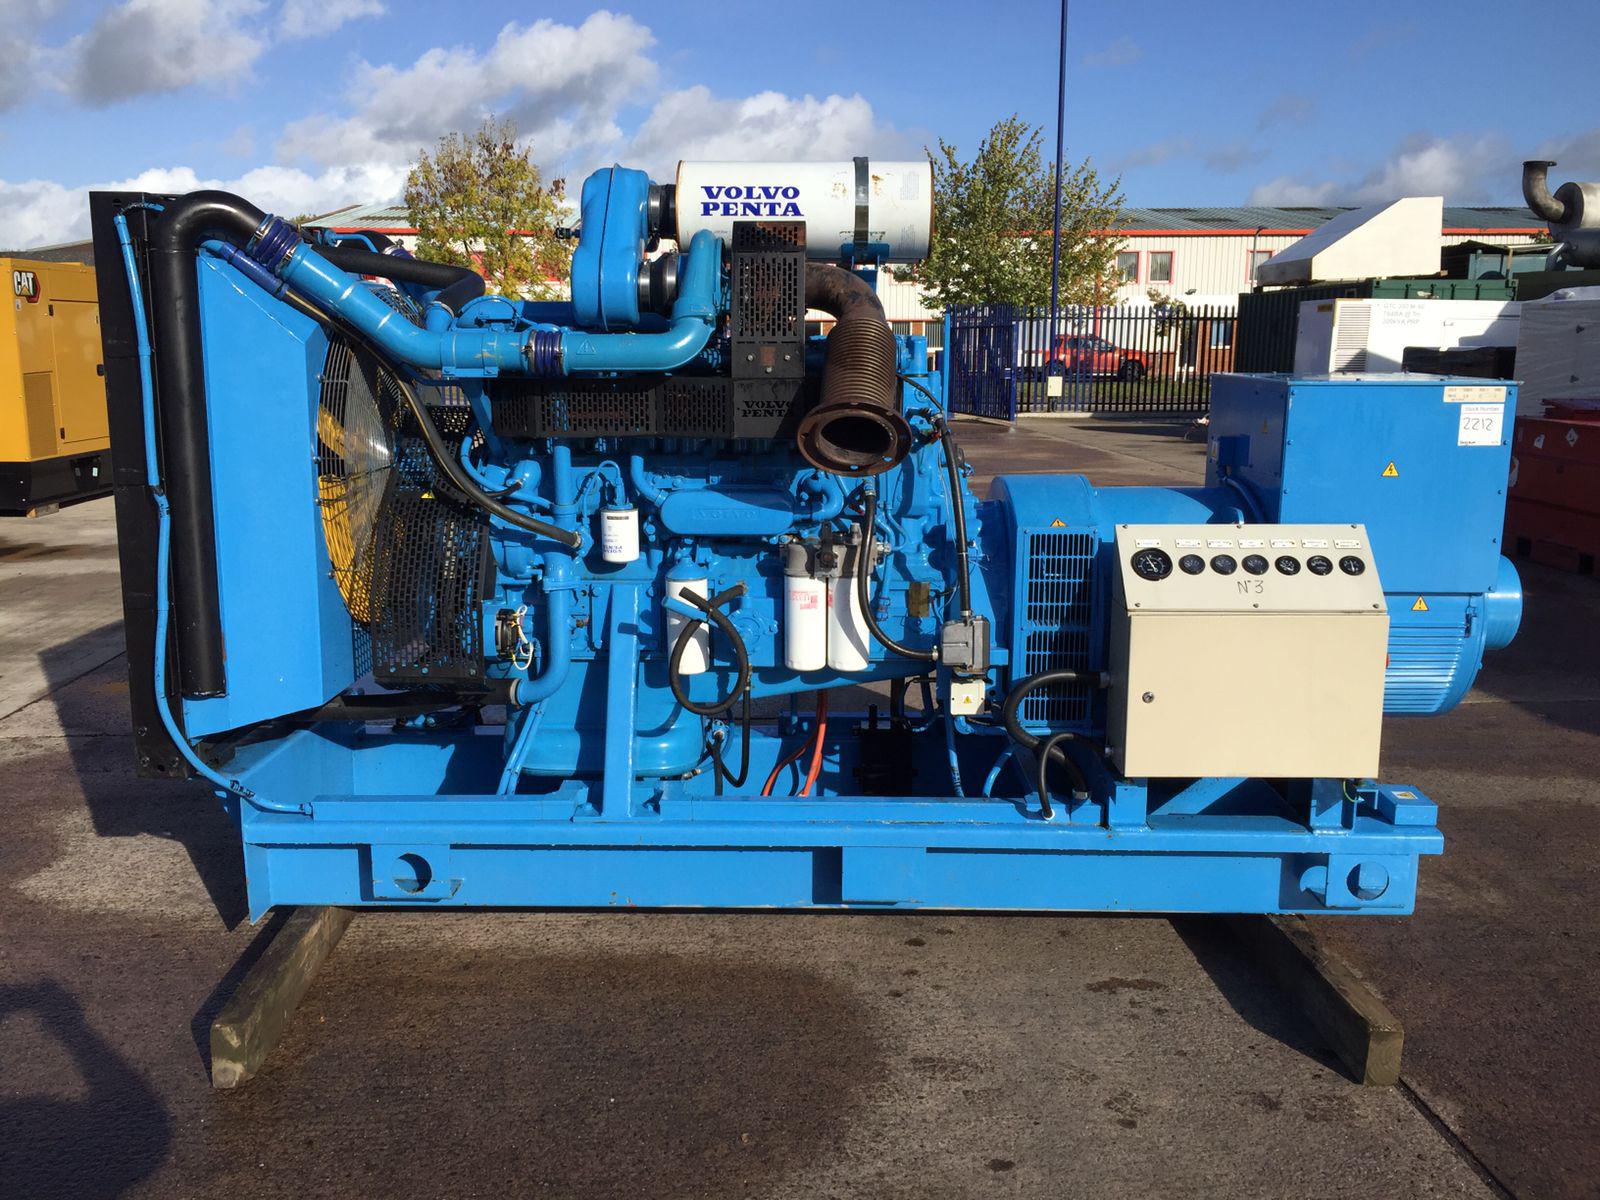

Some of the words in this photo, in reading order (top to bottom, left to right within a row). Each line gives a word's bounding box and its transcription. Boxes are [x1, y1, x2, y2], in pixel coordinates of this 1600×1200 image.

[701, 186, 800, 199] VOLVO
[701, 202, 804, 216] PENTA
[14, 271, 34, 296] CAT
[743, 400, 794, 409] VOLVO
[742, 410, 795, 418] PENTA
[1463, 417, 1493, 431] 2212
